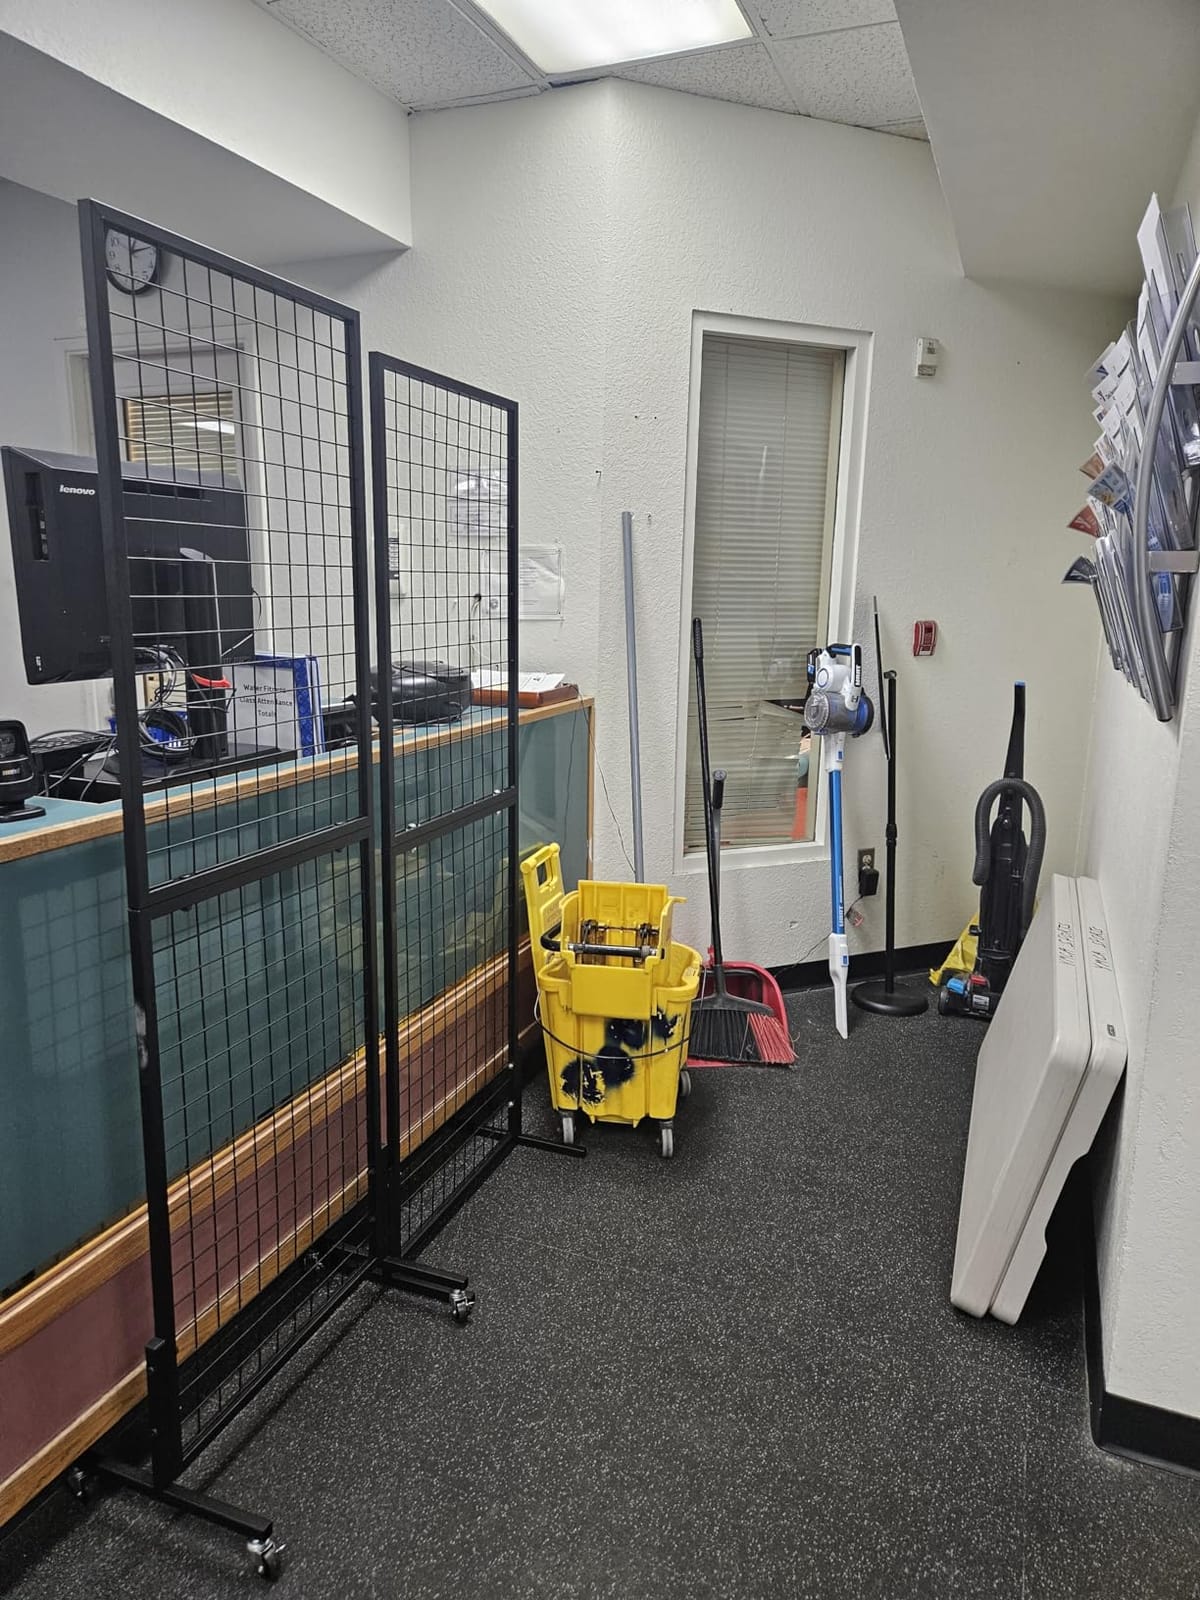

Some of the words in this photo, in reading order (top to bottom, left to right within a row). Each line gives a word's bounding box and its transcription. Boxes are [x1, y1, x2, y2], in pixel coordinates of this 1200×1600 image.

[60, 484, 96, 496] lenovo
[257, 698, 292, 706] Attenance
[258, 709, 277, 717] Total
